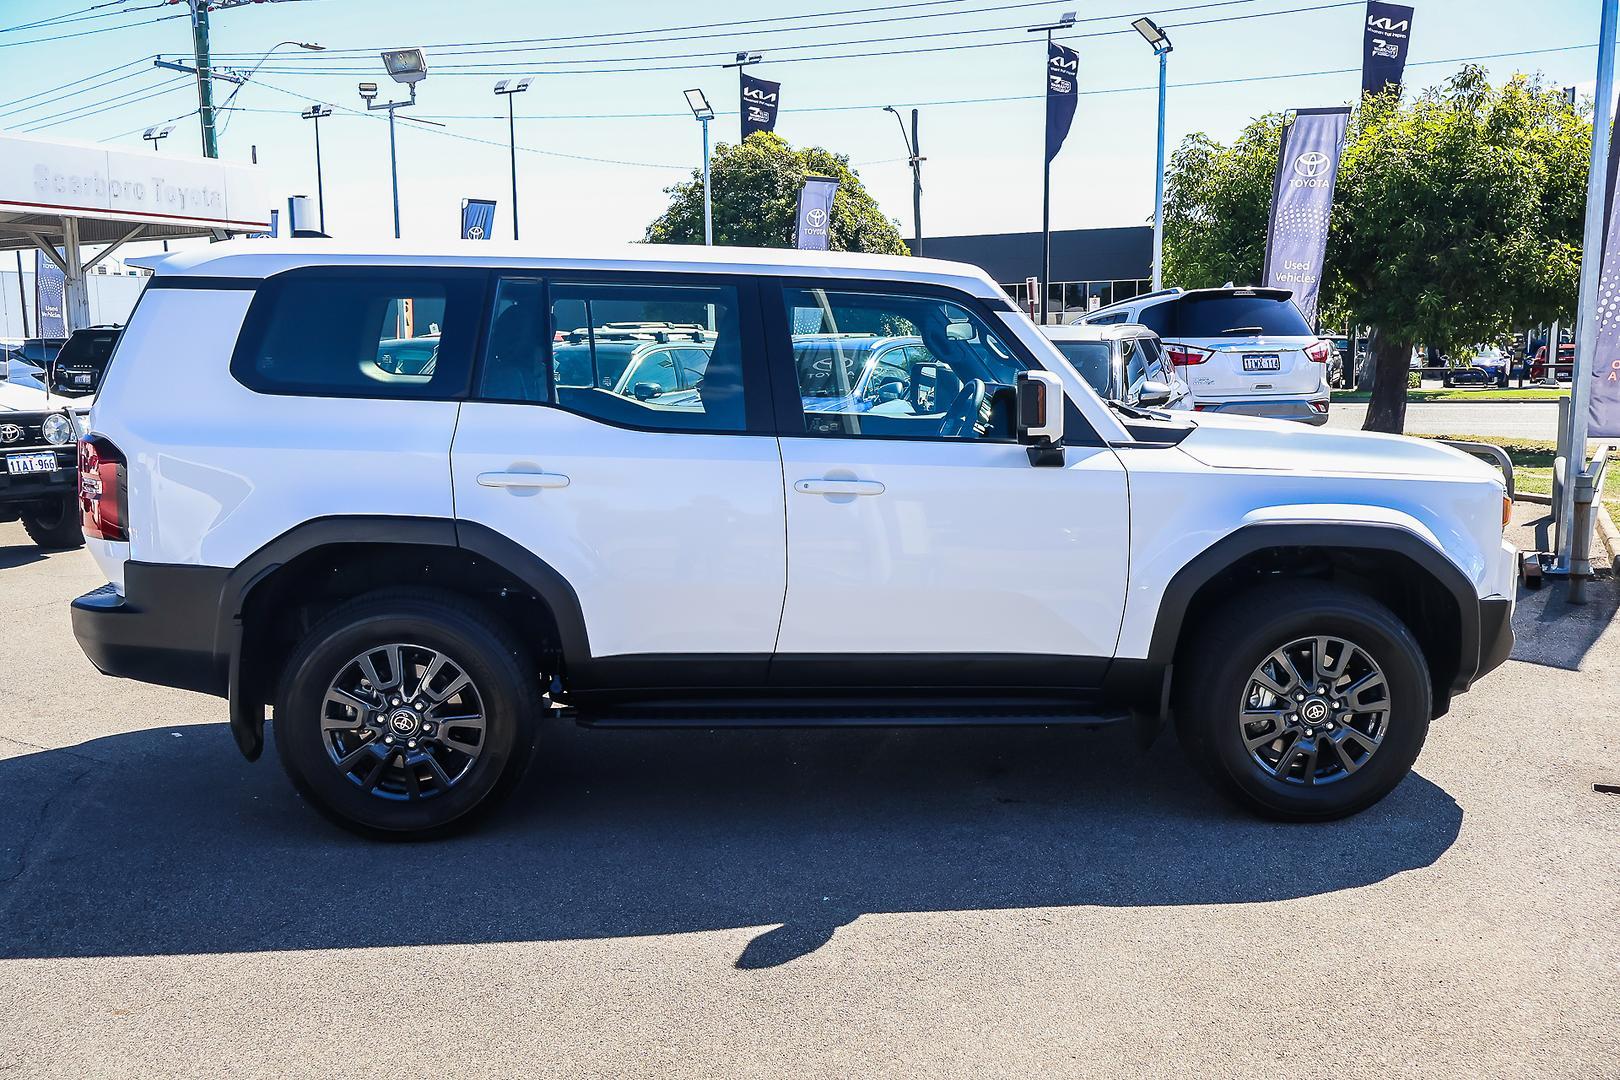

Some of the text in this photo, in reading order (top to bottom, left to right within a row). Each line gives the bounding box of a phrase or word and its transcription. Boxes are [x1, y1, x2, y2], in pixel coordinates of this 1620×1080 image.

[1368, 15, 1408, 31] KIA
[743, 87, 776, 102] KIA
[1289, 179, 1329, 188] TOYOTA
[1285, 261, 1310, 270] Used
[1276, 272, 1316, 284] Vehicles
[807, 370, 855, 379] TOYA
